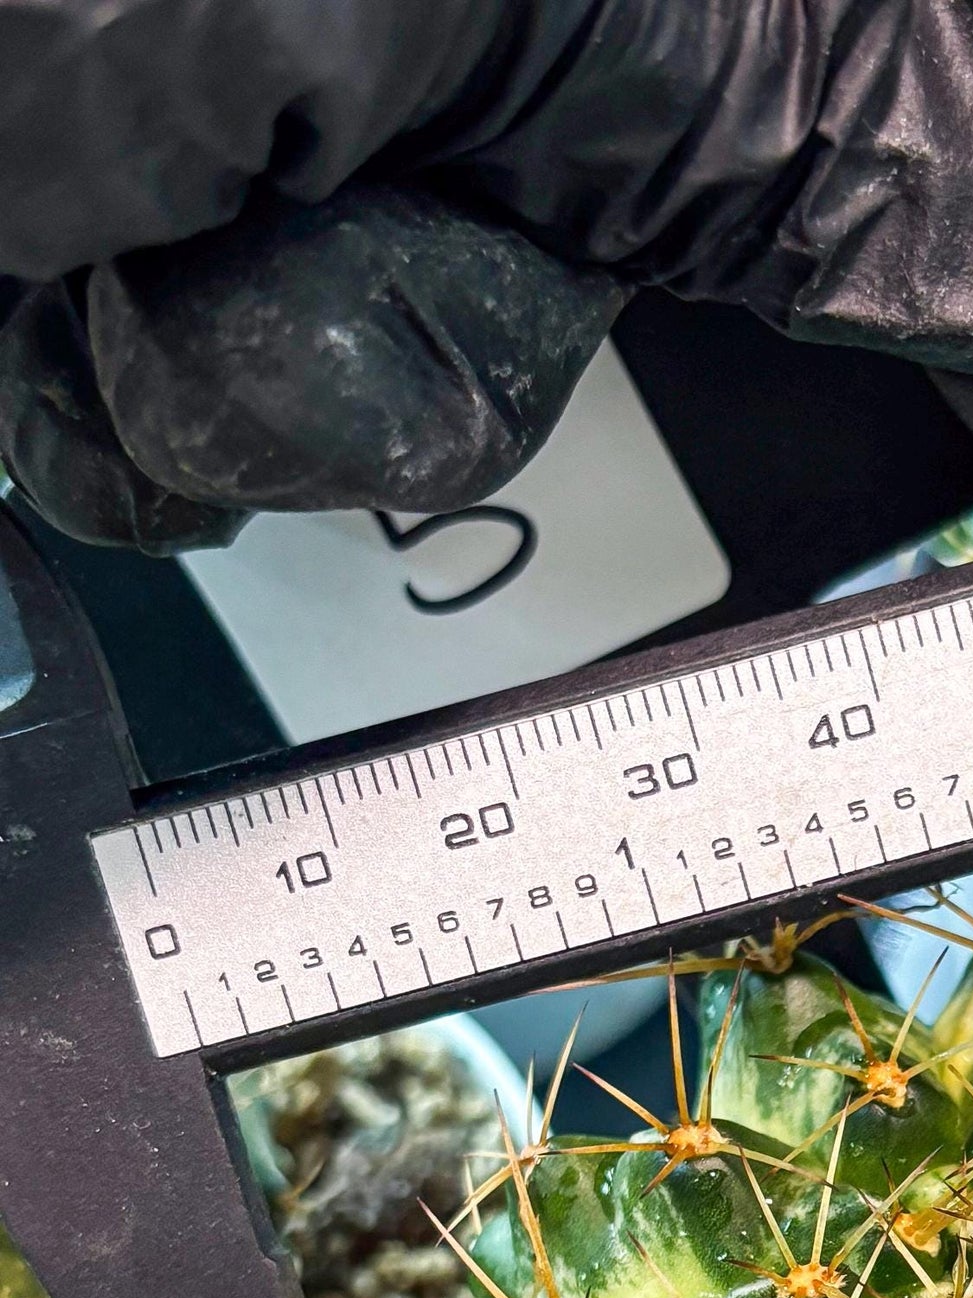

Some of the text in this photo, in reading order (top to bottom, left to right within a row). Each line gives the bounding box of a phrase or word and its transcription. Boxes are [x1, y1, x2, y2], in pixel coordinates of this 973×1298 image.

[144, 923, 181, 960] 0
[275, 850, 332, 894] 10
[440, 801, 515, 850] 20
[623, 752, 698, 800] 30
[808, 703, 876, 750] 40
[218, 972, 231, 991] 1
[253, 959, 279, 983] 2
[299, 947, 323, 969] 3
[347, 934, 367, 957] 4
[390, 922, 413, 946] 5
[436, 910, 460, 934] 6
[485, 897, 504, 920] 7
[527, 885, 553, 910] 8
[574, 873, 599, 898] 9
[614, 836, 635, 870] 1
[676, 849, 688, 869] 1
[711, 837, 736, 860] 2
[757, 824, 780, 847] 3
[804, 812, 824, 834] 4
[847, 799, 869, 823] 5
[893, 786, 916, 810] 6
[942, 773, 960, 796] 7
